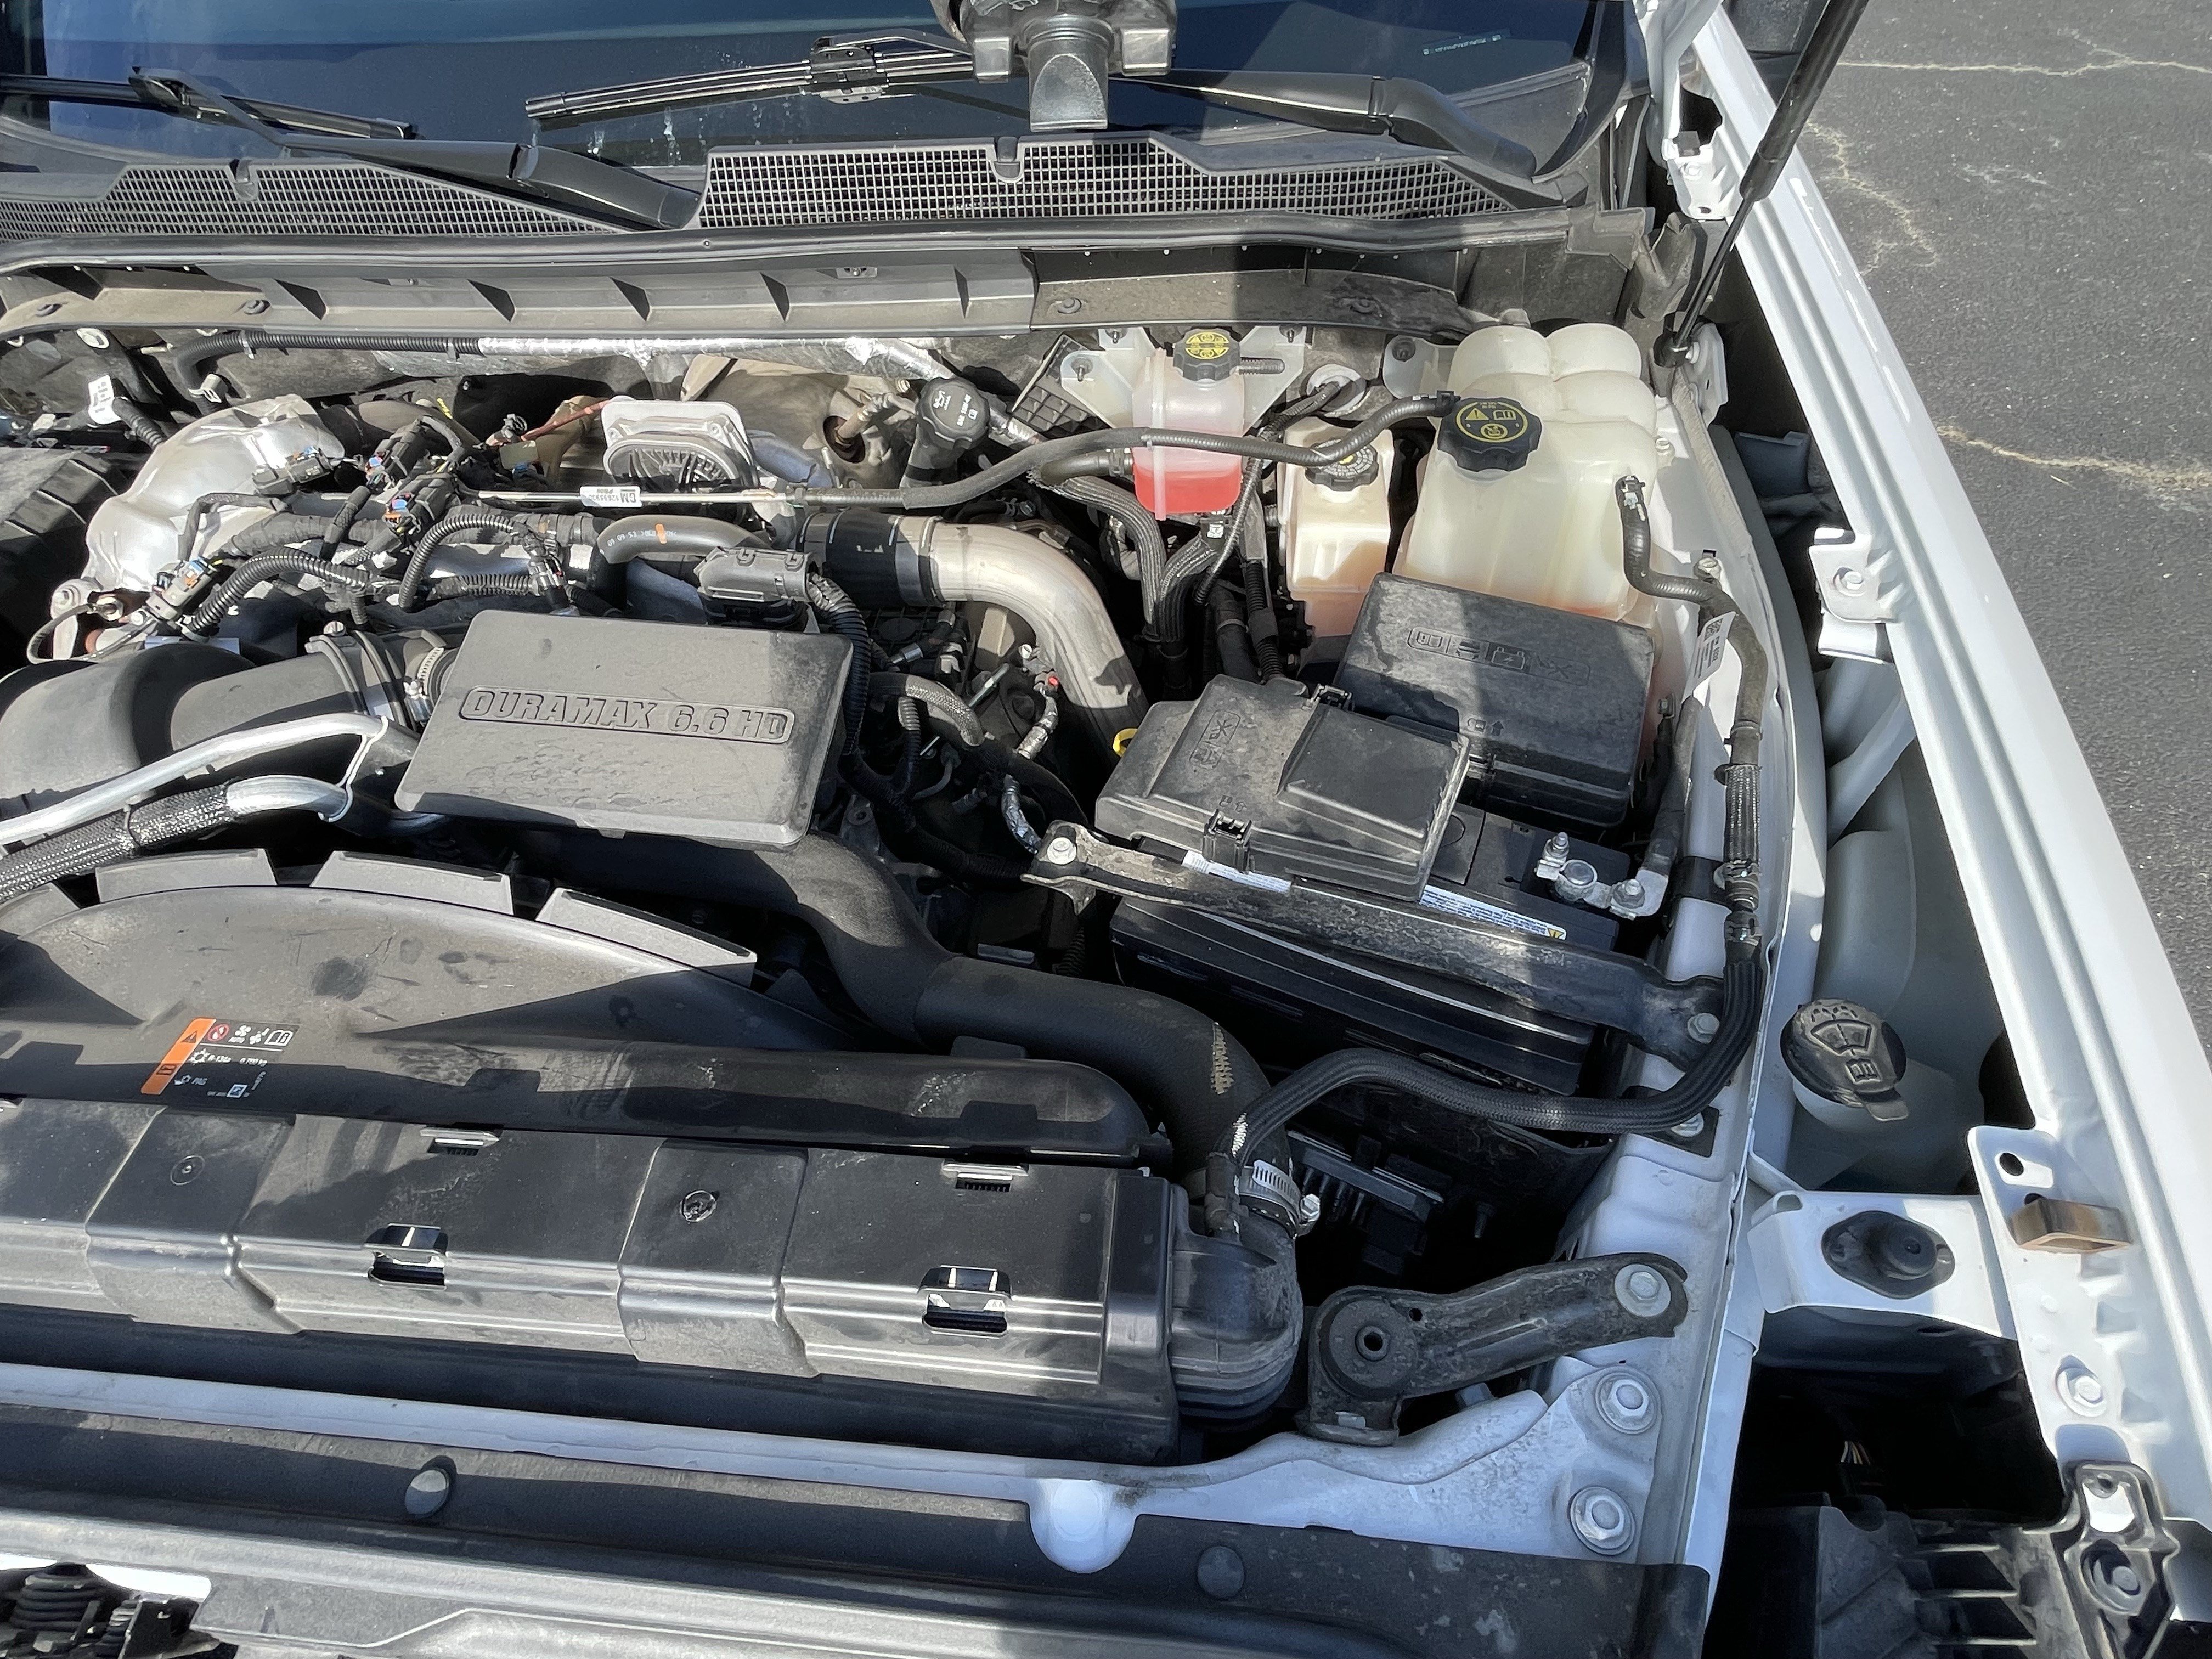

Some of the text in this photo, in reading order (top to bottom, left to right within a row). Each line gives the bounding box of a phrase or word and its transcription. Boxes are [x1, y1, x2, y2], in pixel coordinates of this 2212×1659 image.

[620, 493, 636, 503] GM
[472, 689, 788, 739] DURAMAX 6.6 HD
